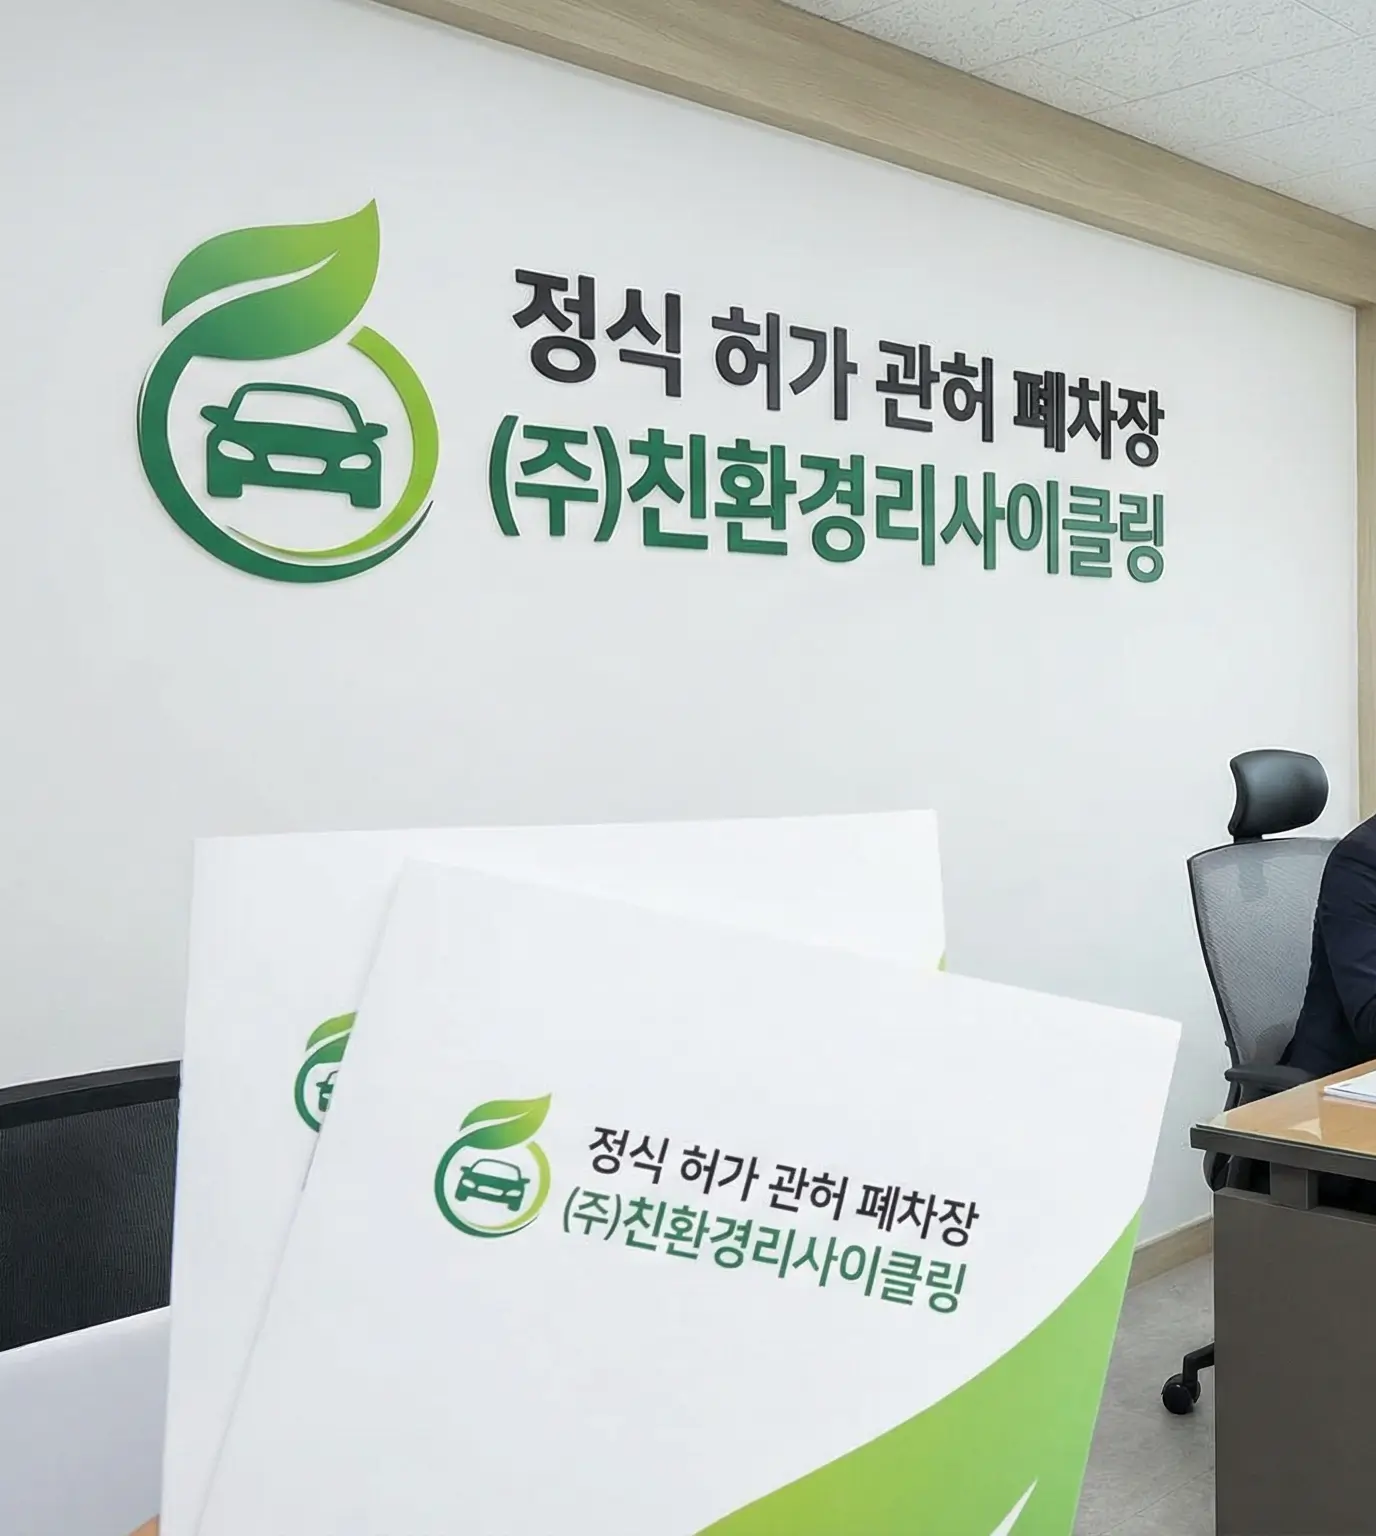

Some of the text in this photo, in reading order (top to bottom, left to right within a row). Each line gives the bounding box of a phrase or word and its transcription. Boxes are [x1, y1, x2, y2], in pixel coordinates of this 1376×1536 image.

[512, 268, 1165, 468] 정식 허가 관허 폐차장
[489, 415, 1164, 583] (주)친환경리사이클링
[562, 1186, 967, 1314] (주)친환경리사이클링
[588, 1126, 980, 1247] 정식 허가 관허 폐차장
